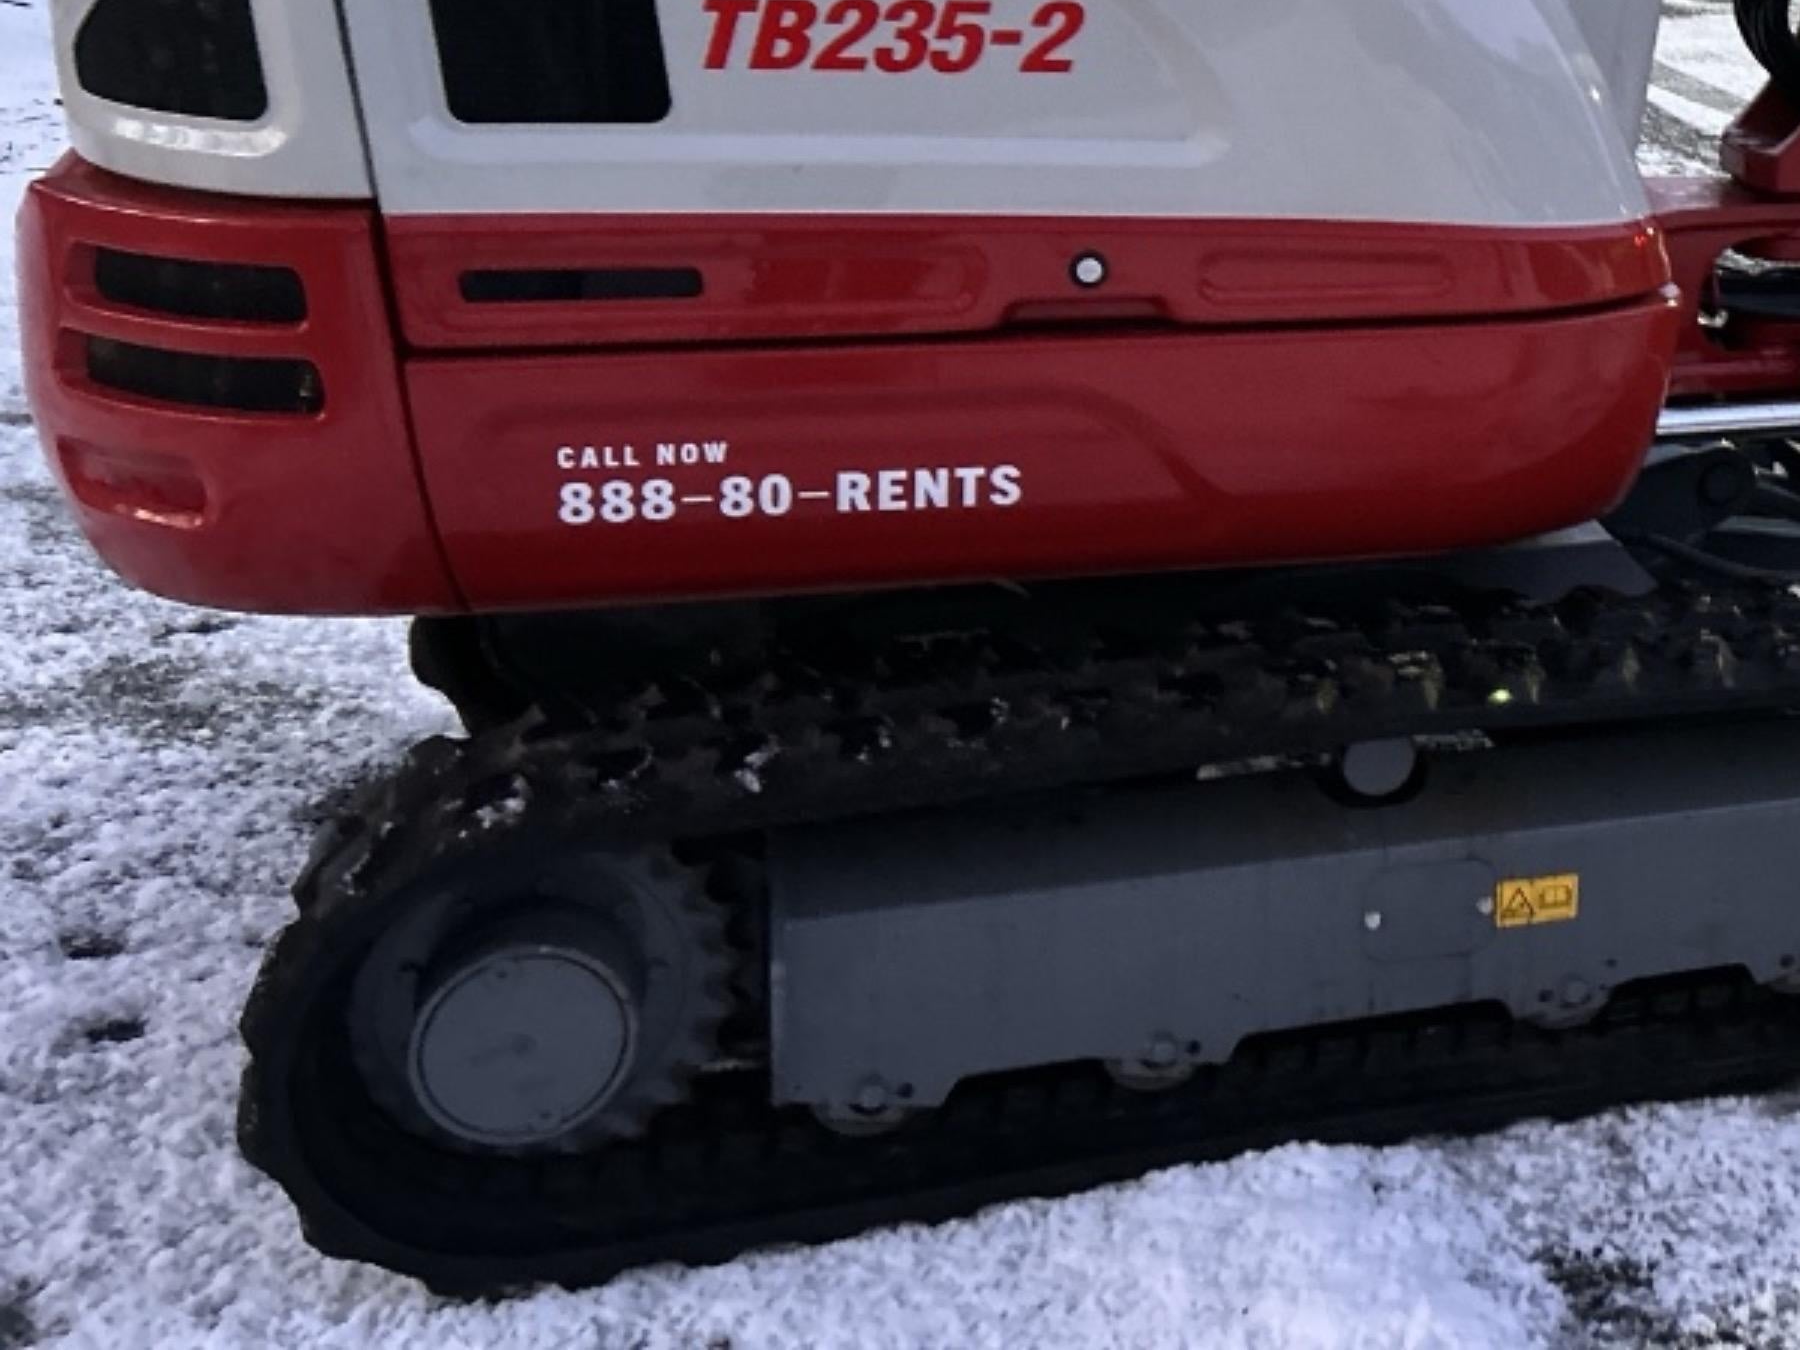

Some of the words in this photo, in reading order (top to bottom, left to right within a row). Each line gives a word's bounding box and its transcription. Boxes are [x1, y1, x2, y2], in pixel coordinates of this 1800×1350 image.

[556, 446, 640, 469] CALL
[656, 442, 729, 466] NOW
[557, 464, 1022, 525] 888-80-RENTS
